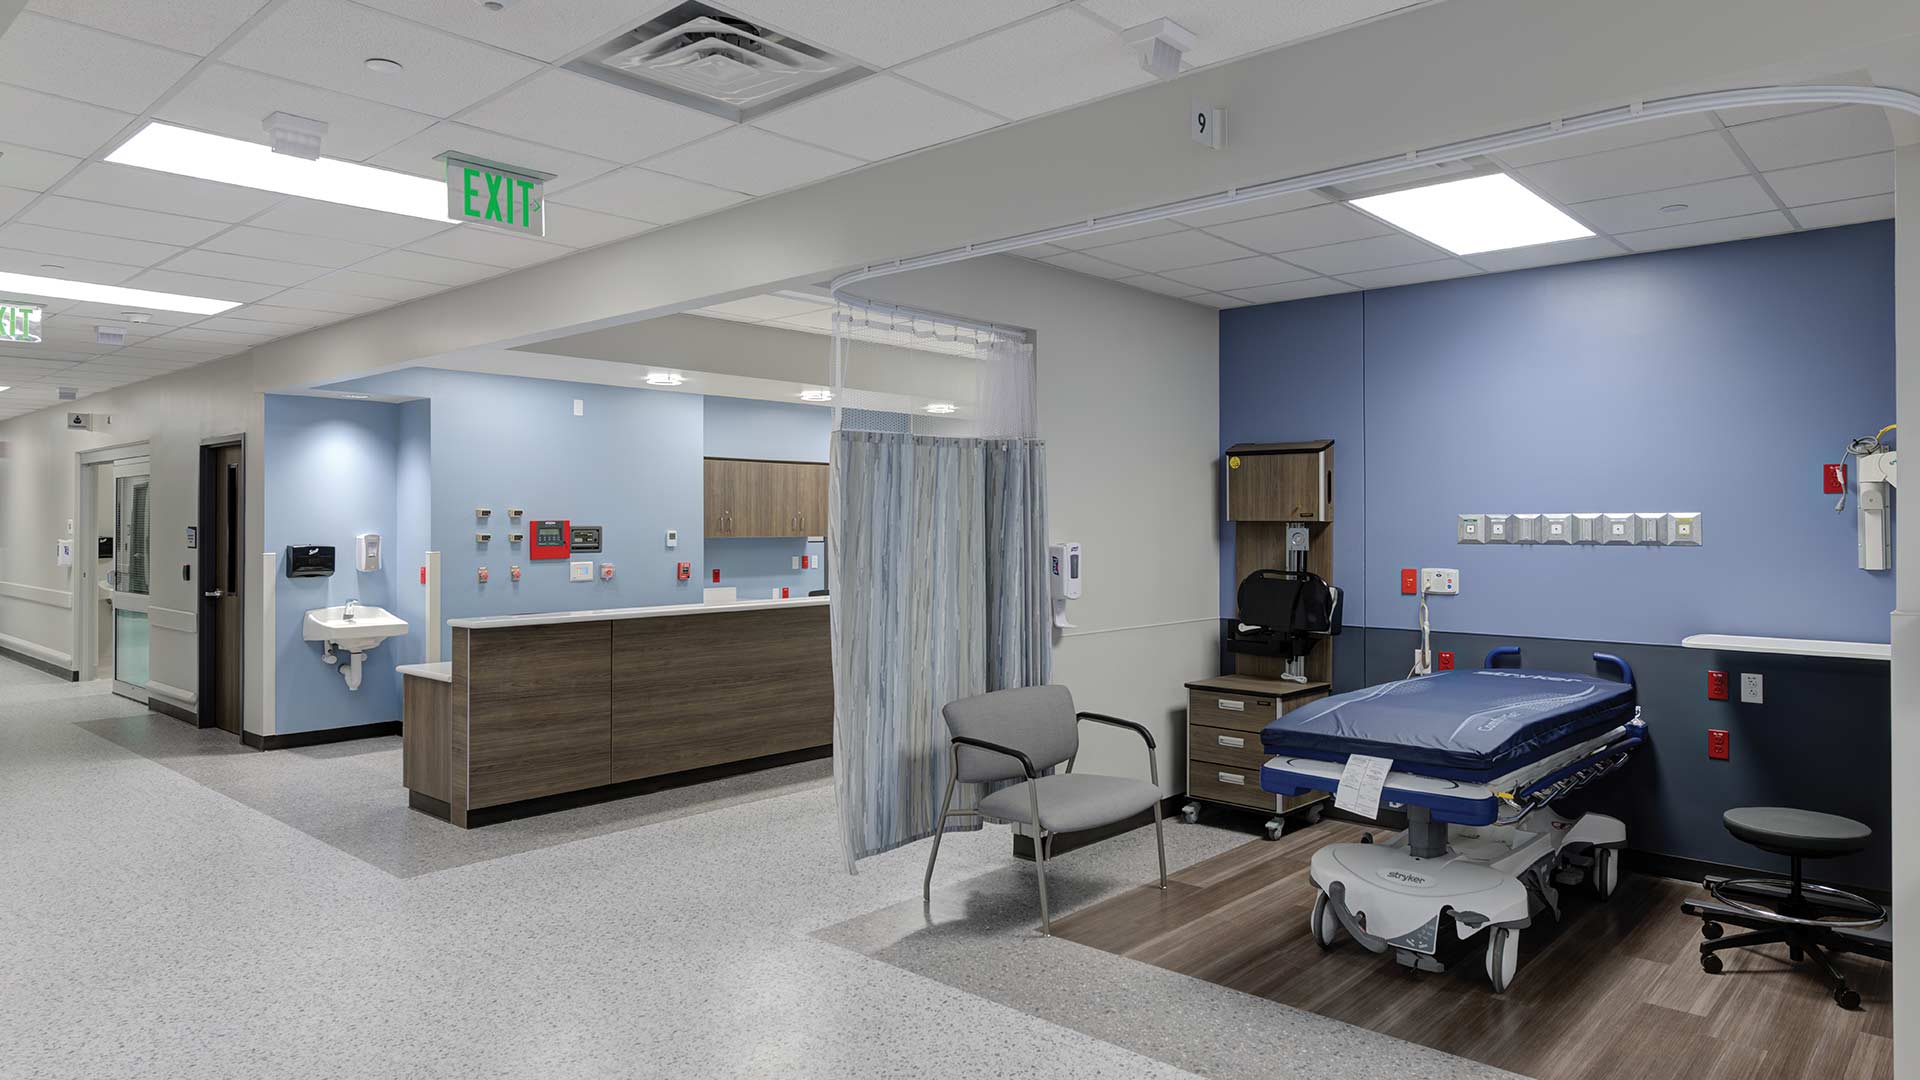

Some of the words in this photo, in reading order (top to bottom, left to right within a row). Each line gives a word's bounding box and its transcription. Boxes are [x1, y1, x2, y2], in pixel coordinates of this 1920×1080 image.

[1198, 112, 1206, 134] 9
[463, 167, 534, 228] EXIT
[1386, 871, 1426, 884] stryker
